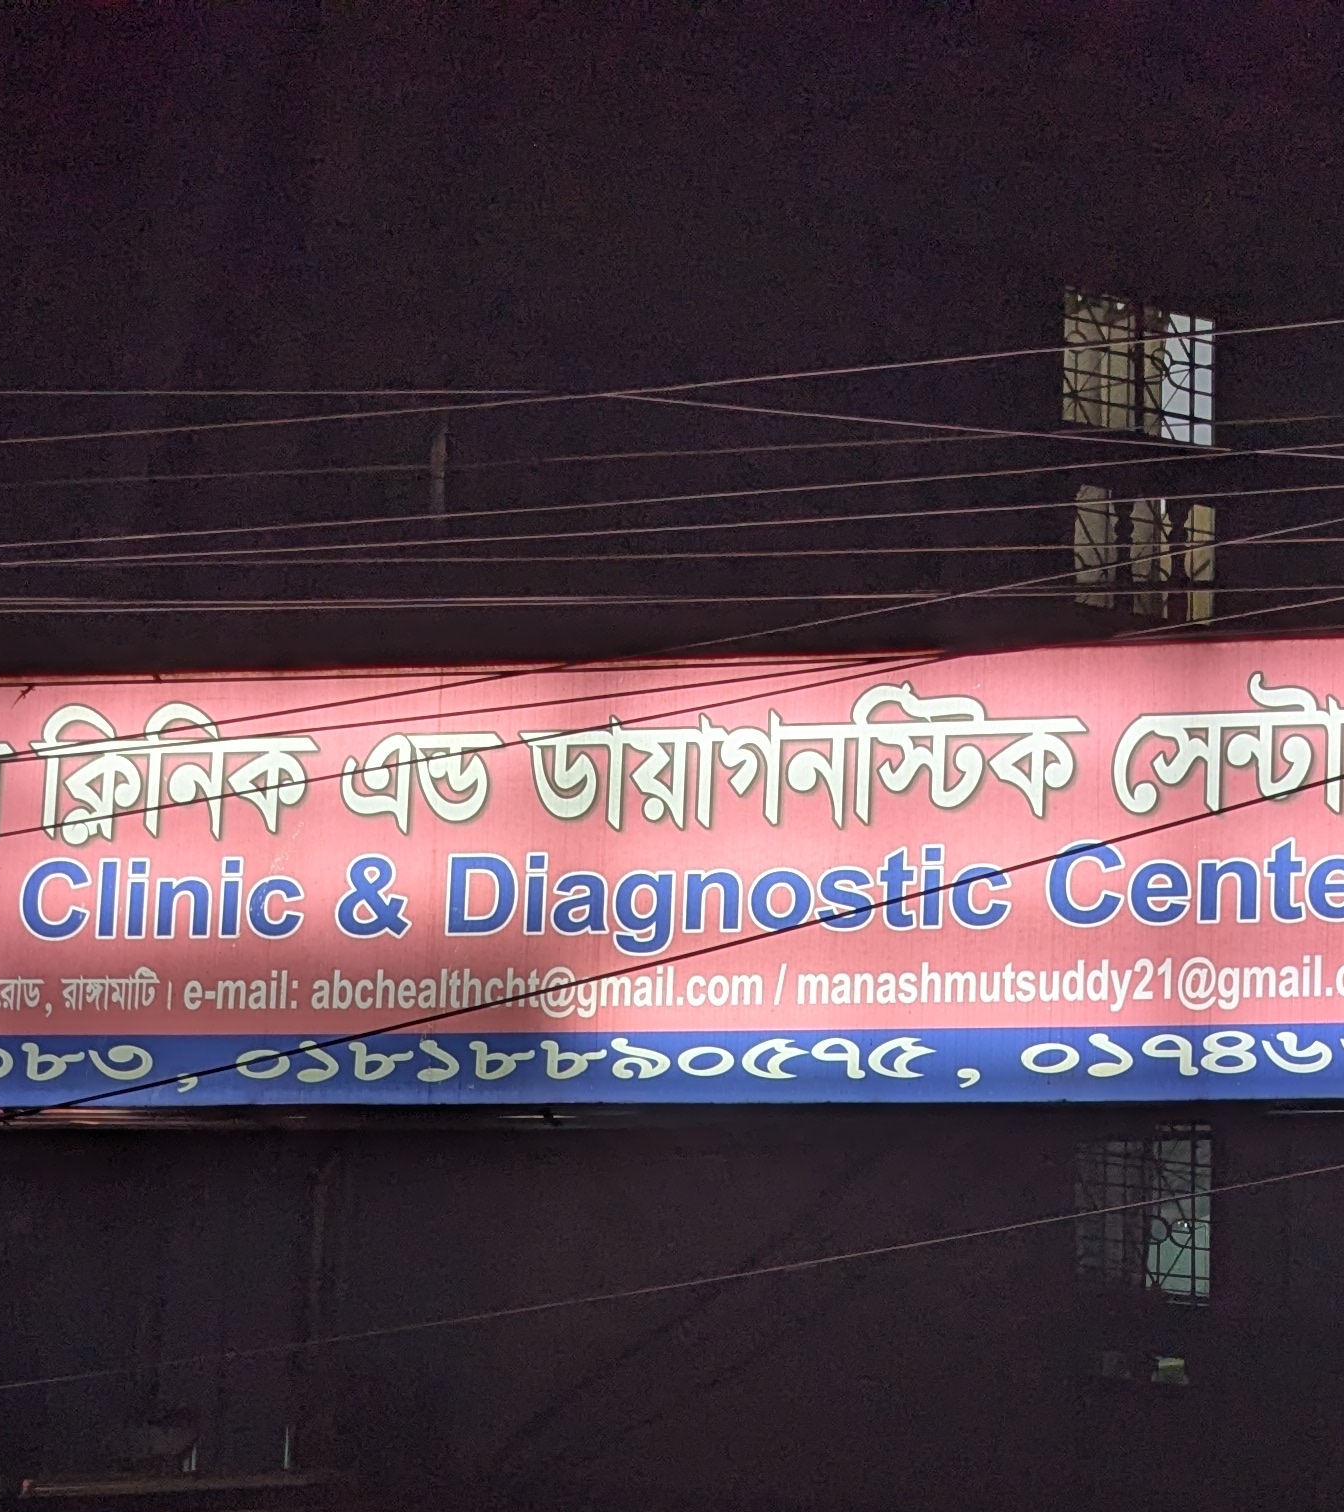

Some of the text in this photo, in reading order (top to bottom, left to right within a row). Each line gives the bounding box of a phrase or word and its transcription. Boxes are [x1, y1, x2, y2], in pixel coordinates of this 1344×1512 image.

[32, 702, 319, 846] ক্লিনিক
[341, 733, 505, 835] এন্ড
[520, 681, 1088, 830] ডায়াগনস্টিক
[20, 857, 304, 942] Clinic
[336, 853, 411, 938] &
[445, 845, 1011, 956] Diagnostic
[184, 970, 298, 1010] e-mail:
[312, 963, 764, 1018] abchealthcht@gmail.com
[774, 963, 787, 1005] /
